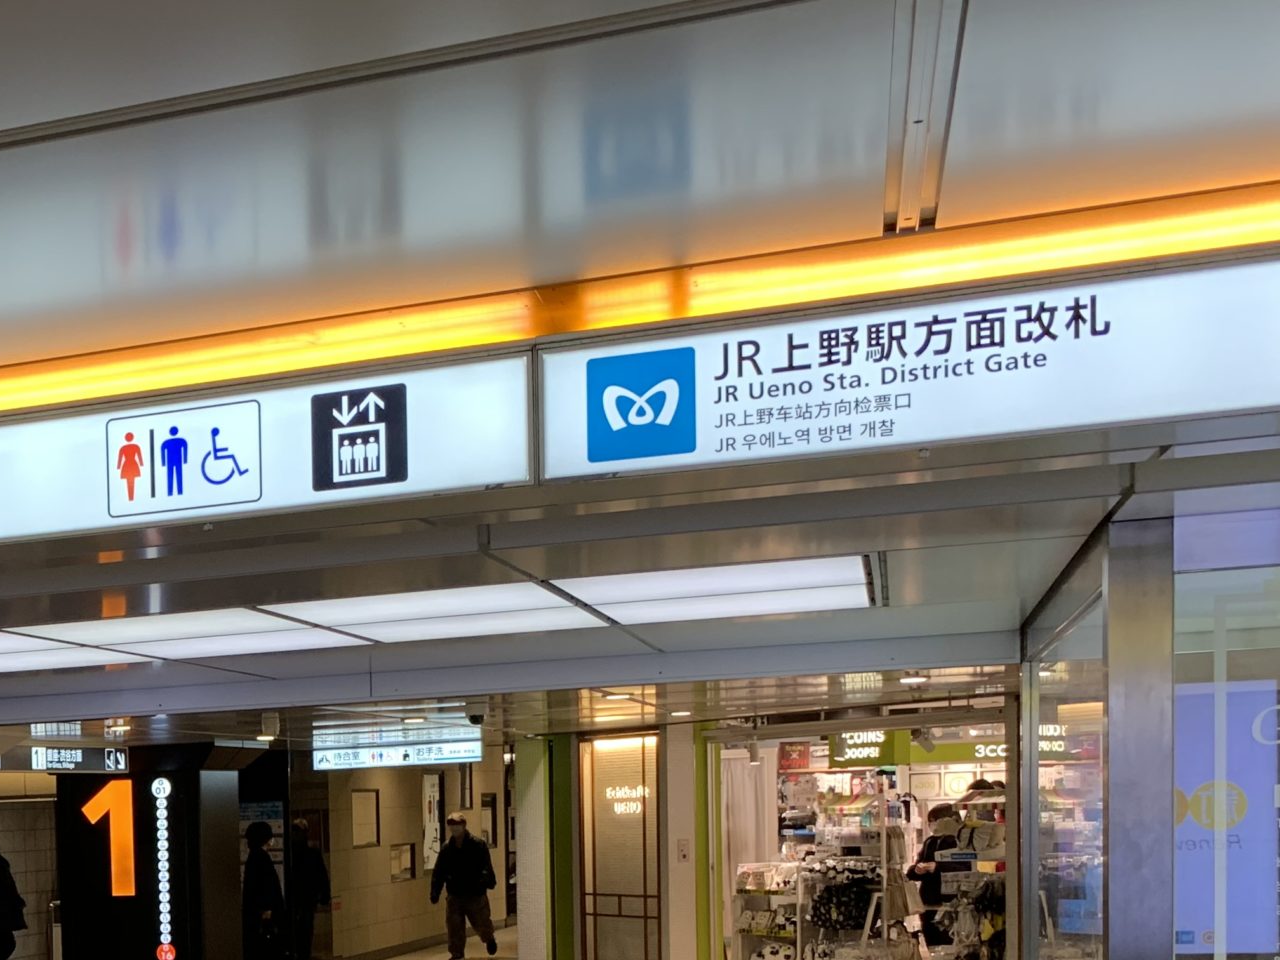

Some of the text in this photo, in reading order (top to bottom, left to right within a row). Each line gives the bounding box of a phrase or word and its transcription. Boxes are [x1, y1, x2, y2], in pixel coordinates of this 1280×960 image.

[714, 295, 1111, 381] JR上野駅方面改札
[714, 350, 1047, 404] JR Ueno Sta. District Gate
[714, 393, 912, 428] JR上野车站方向检票口
[715, 419, 895, 452] JR 우에노역 방면 개찰
[841, 730, 885, 744] COINS
[333, 751, 360, 761] 待合室
[155, 787, 166, 795] 01
[81, 779, 136, 896] 1
